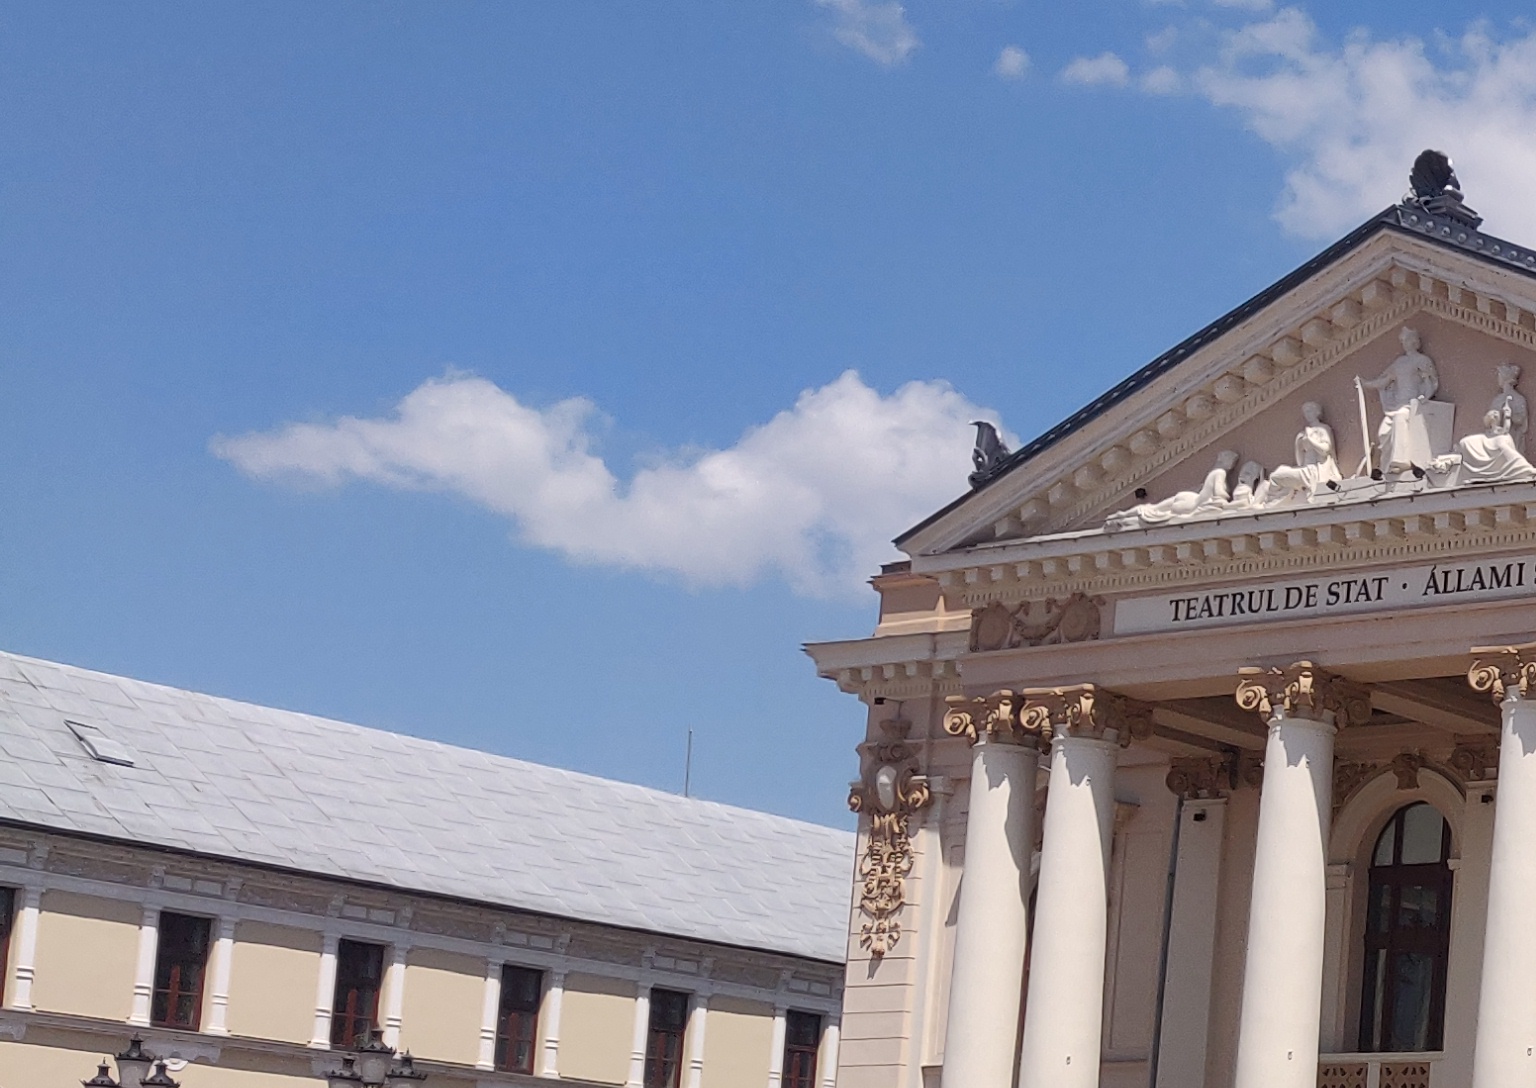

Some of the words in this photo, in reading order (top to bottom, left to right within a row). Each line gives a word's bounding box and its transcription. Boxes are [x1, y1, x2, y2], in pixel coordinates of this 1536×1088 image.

[1169, 588, 1279, 622] TEATRUL
[1283, 584, 1319, 611] DE
[1325, 577, 1389, 606] STAT
[1422, 562, 1526, 596] ÁLLAMI
